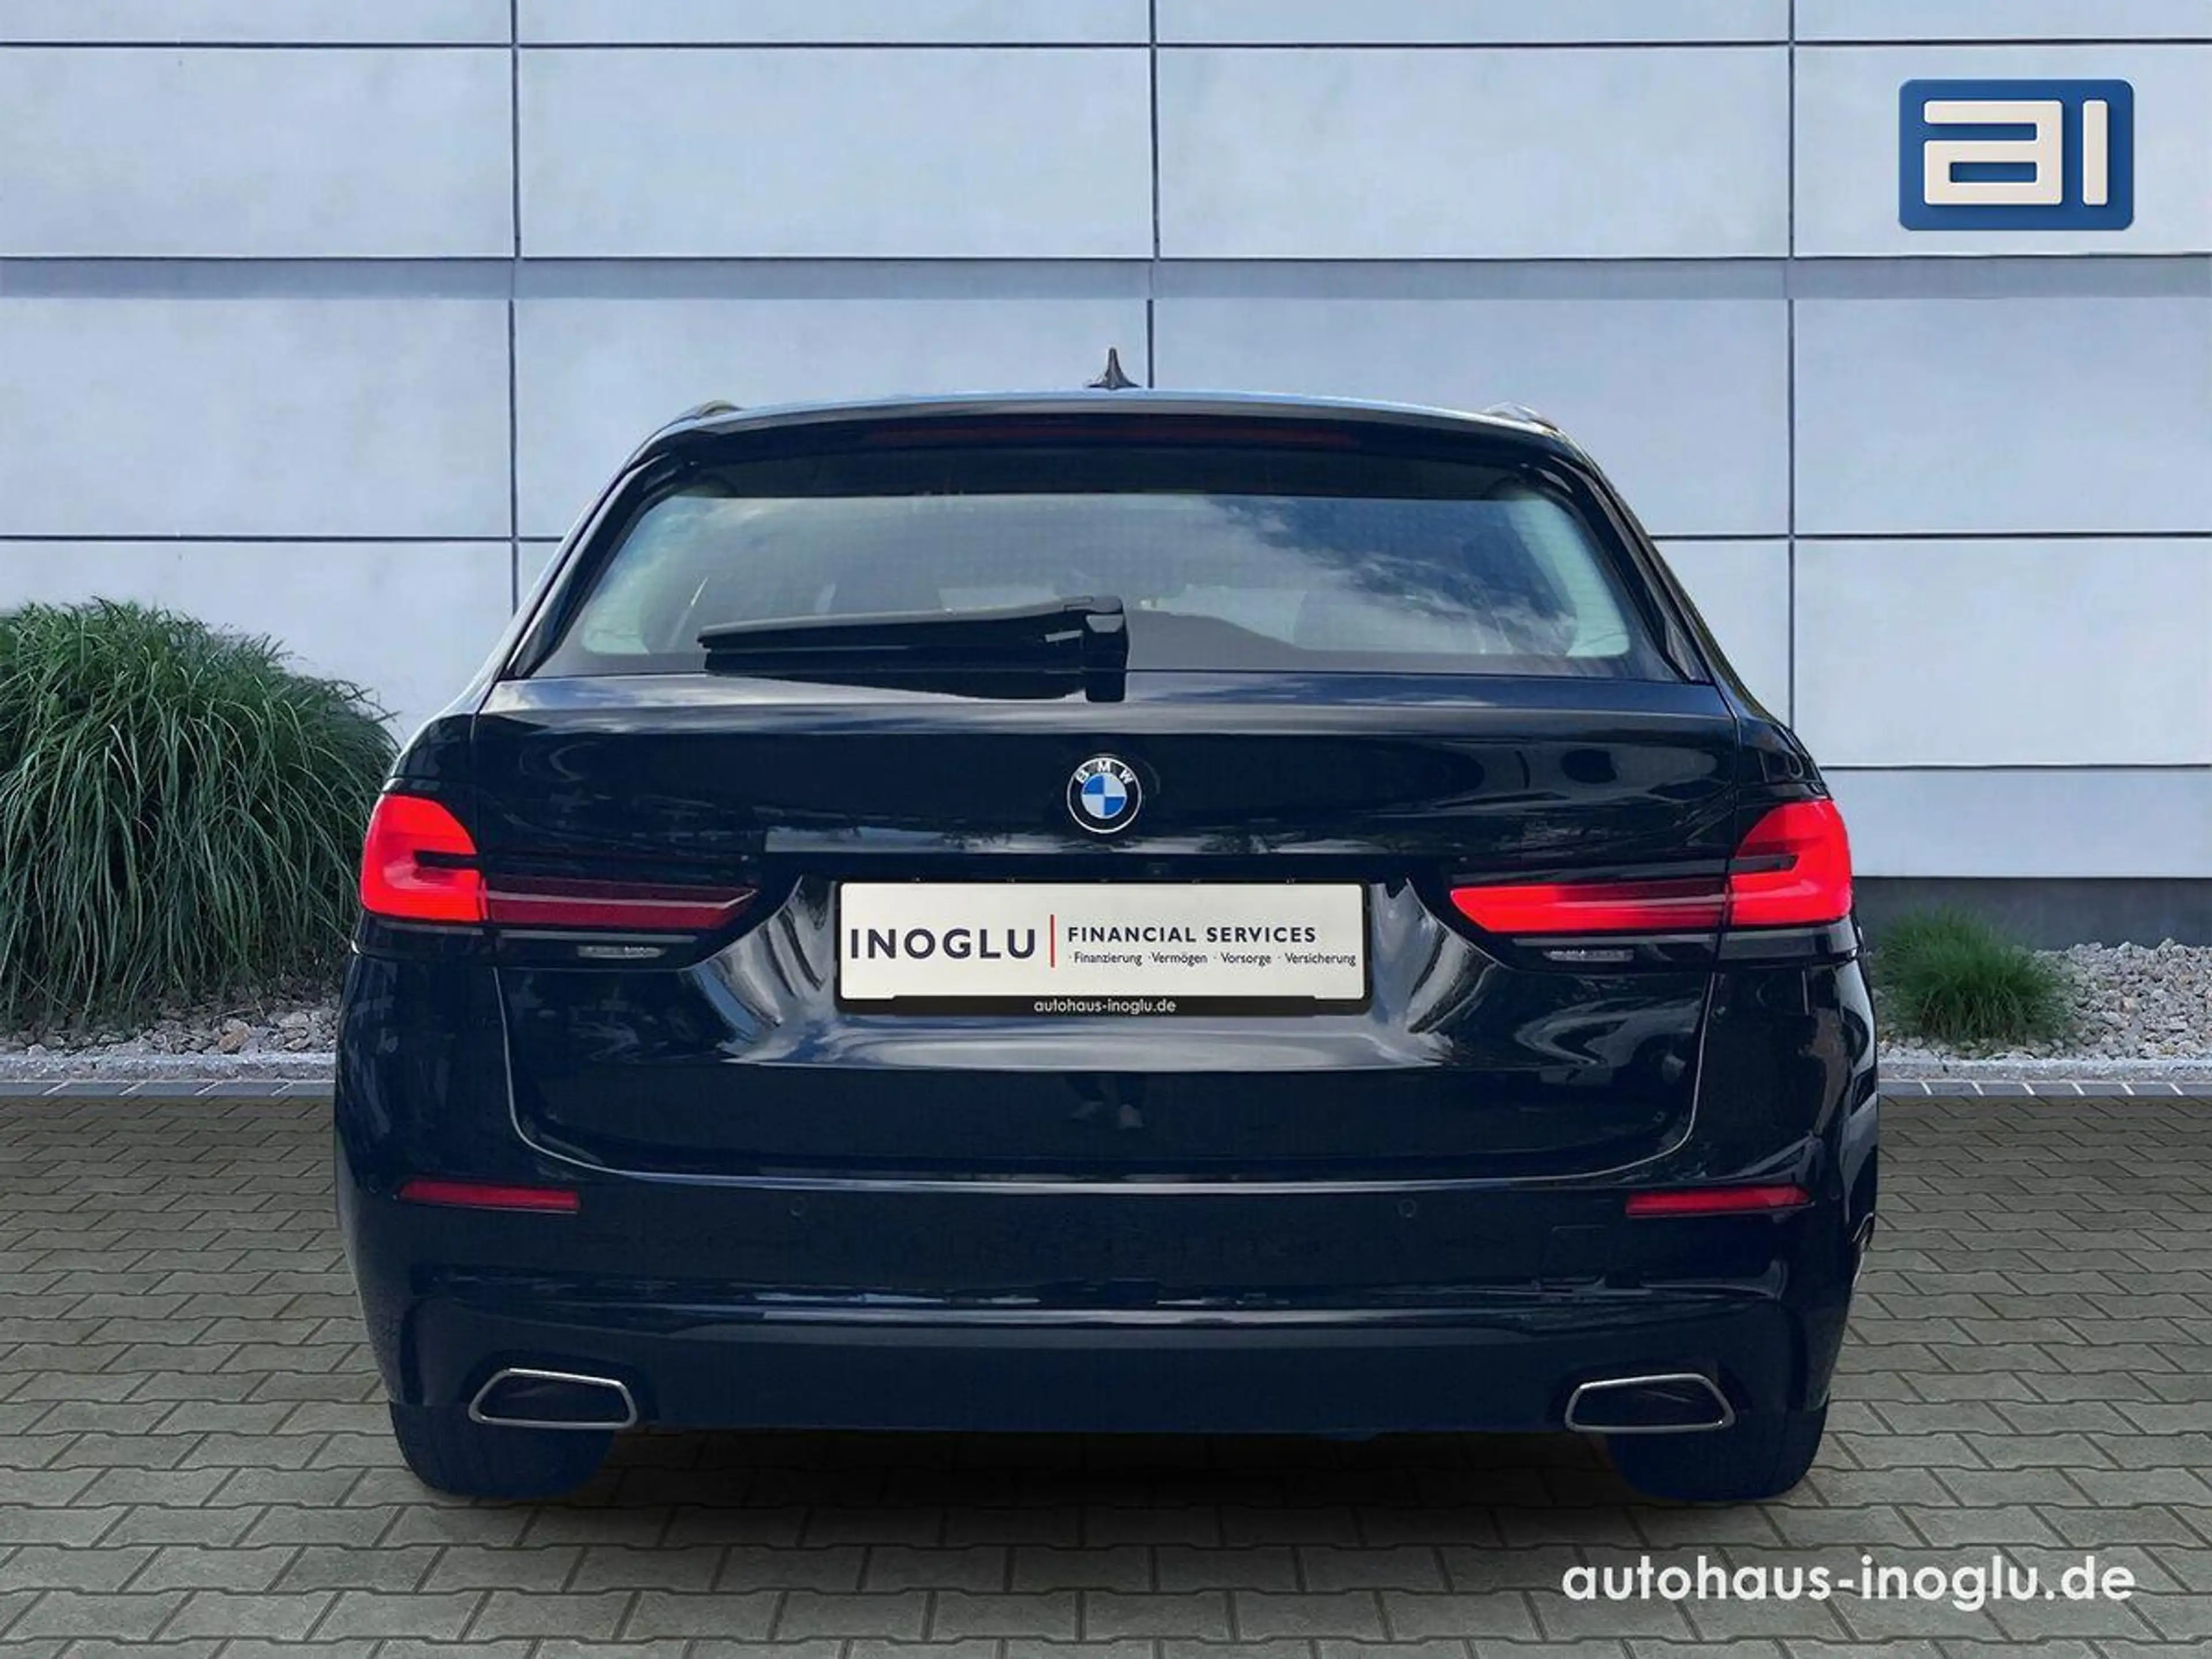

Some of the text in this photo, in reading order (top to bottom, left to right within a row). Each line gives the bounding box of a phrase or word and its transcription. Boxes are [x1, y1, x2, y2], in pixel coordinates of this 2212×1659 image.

[1075, 760, 1134, 784] BMW
[850, 927, 1036, 960] INOGLU
[1067, 926, 1316, 944] FINANCIAL SERVICES
[1073, 950, 1357, 968] Finanzierung Vermögen Vorsorge Versicherung
[1033, 998, 1177, 1015] autohaus-inoglu.de
